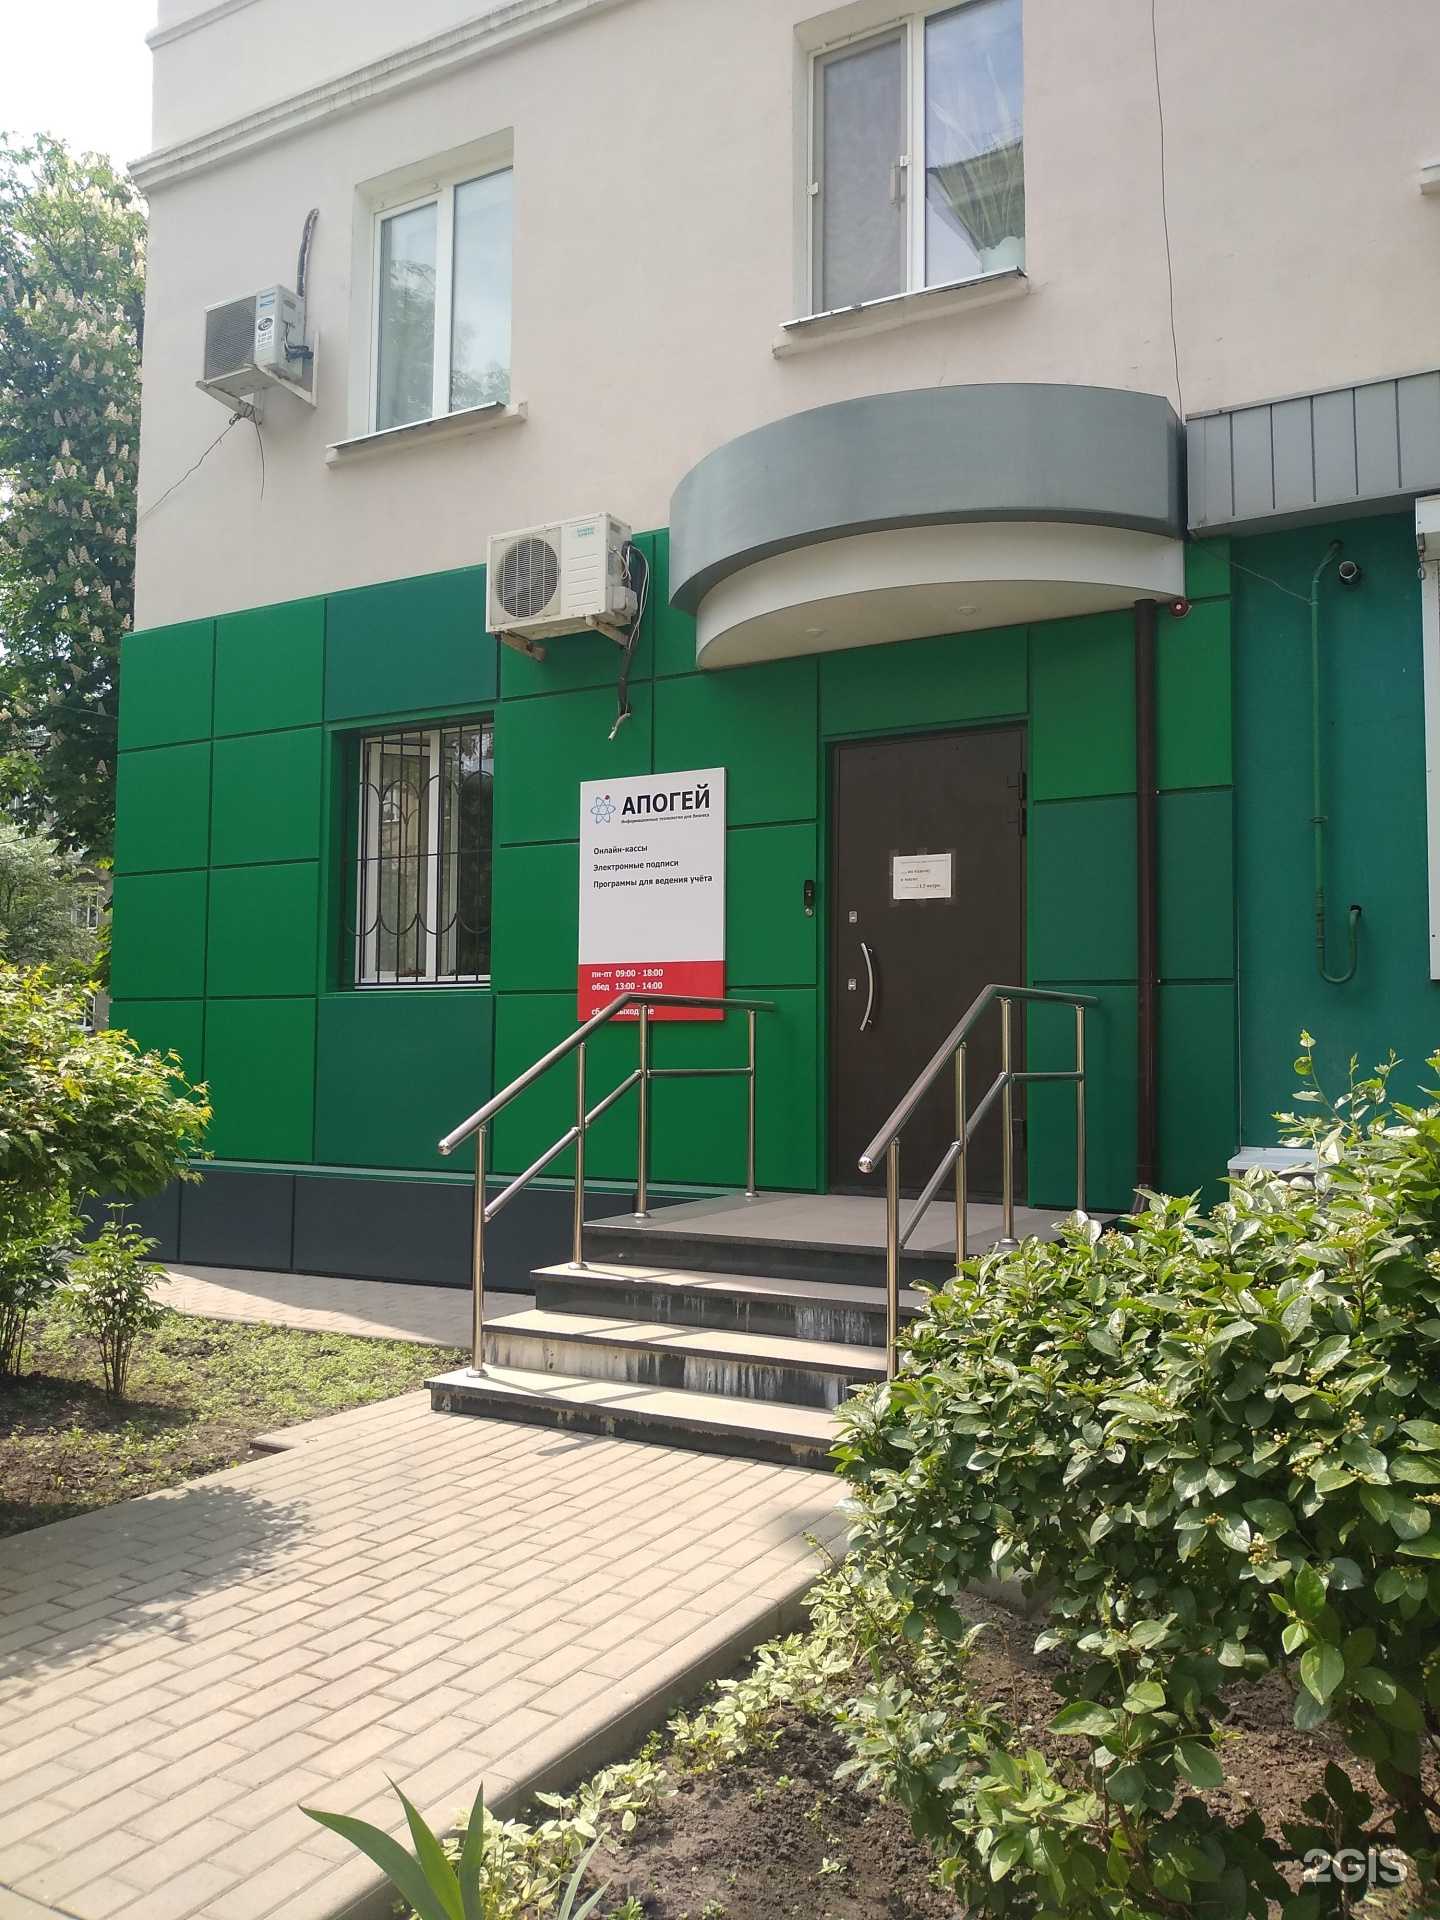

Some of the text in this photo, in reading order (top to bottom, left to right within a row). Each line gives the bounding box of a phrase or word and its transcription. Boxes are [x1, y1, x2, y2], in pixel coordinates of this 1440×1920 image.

[622, 783, 710, 815] АПОГЕЙ
[593, 845, 648, 855] Онлайн-кассы
[593, 860, 679, 872] Электронные подписи
[593, 880, 637, 889] Программы
[655, 877, 688, 886] ведения
[689, 874, 713, 884] учёта
[615, 969, 636, 977] 09:00
[642, 968, 664, 977] 18:00
[591, 982, 610, 991] обед
[615, 982, 636, 990] 13:00
[642, 981, 663, 990] 14:00
